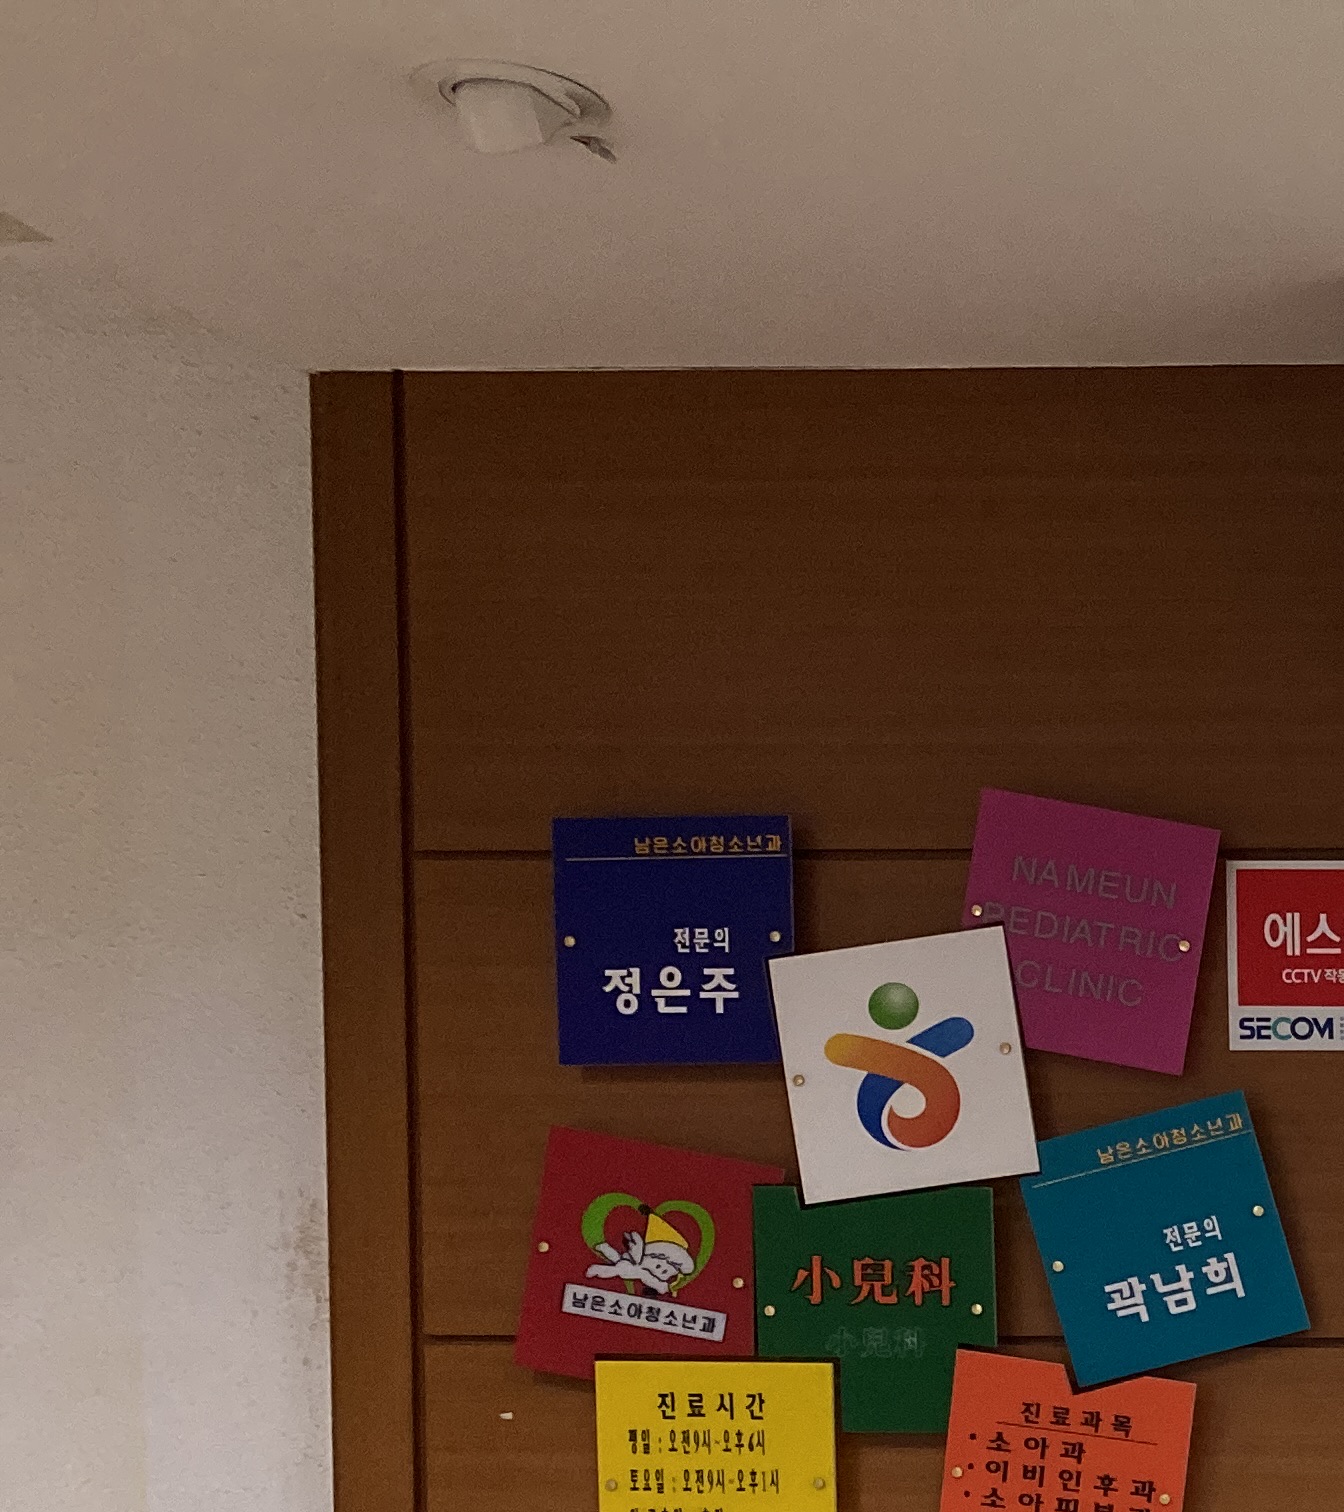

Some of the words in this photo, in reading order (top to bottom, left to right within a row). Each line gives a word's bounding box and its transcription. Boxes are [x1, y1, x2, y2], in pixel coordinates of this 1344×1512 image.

[633, 834, 783, 855] 남은소아청소년과
[1012, 854, 1178, 910] NAMEUN
[673, 927, 730, 953] 전문의
[602, 965, 740, 1015] 정은주
[1014, 958, 1144, 1008] CLINIC
[1282, 967, 1321, 985] CCTV
[1238, 1015, 1335, 1042] SECOM
[1096, 1112, 1245, 1165] 남은소아청소년과
[1162, 1215, 1223, 1252] 전문의
[1103, 1252, 1246, 1323] 곽남희
[571, 1292, 717, 1334] 남은소아청소년과
[657, 1391, 766, 1421] 진료시간
[1020, 1401, 1133, 1438] 진료과목
[985, 1431, 1086, 1464] 소아과
[984, 1460, 1156, 1503] 이비인후과
